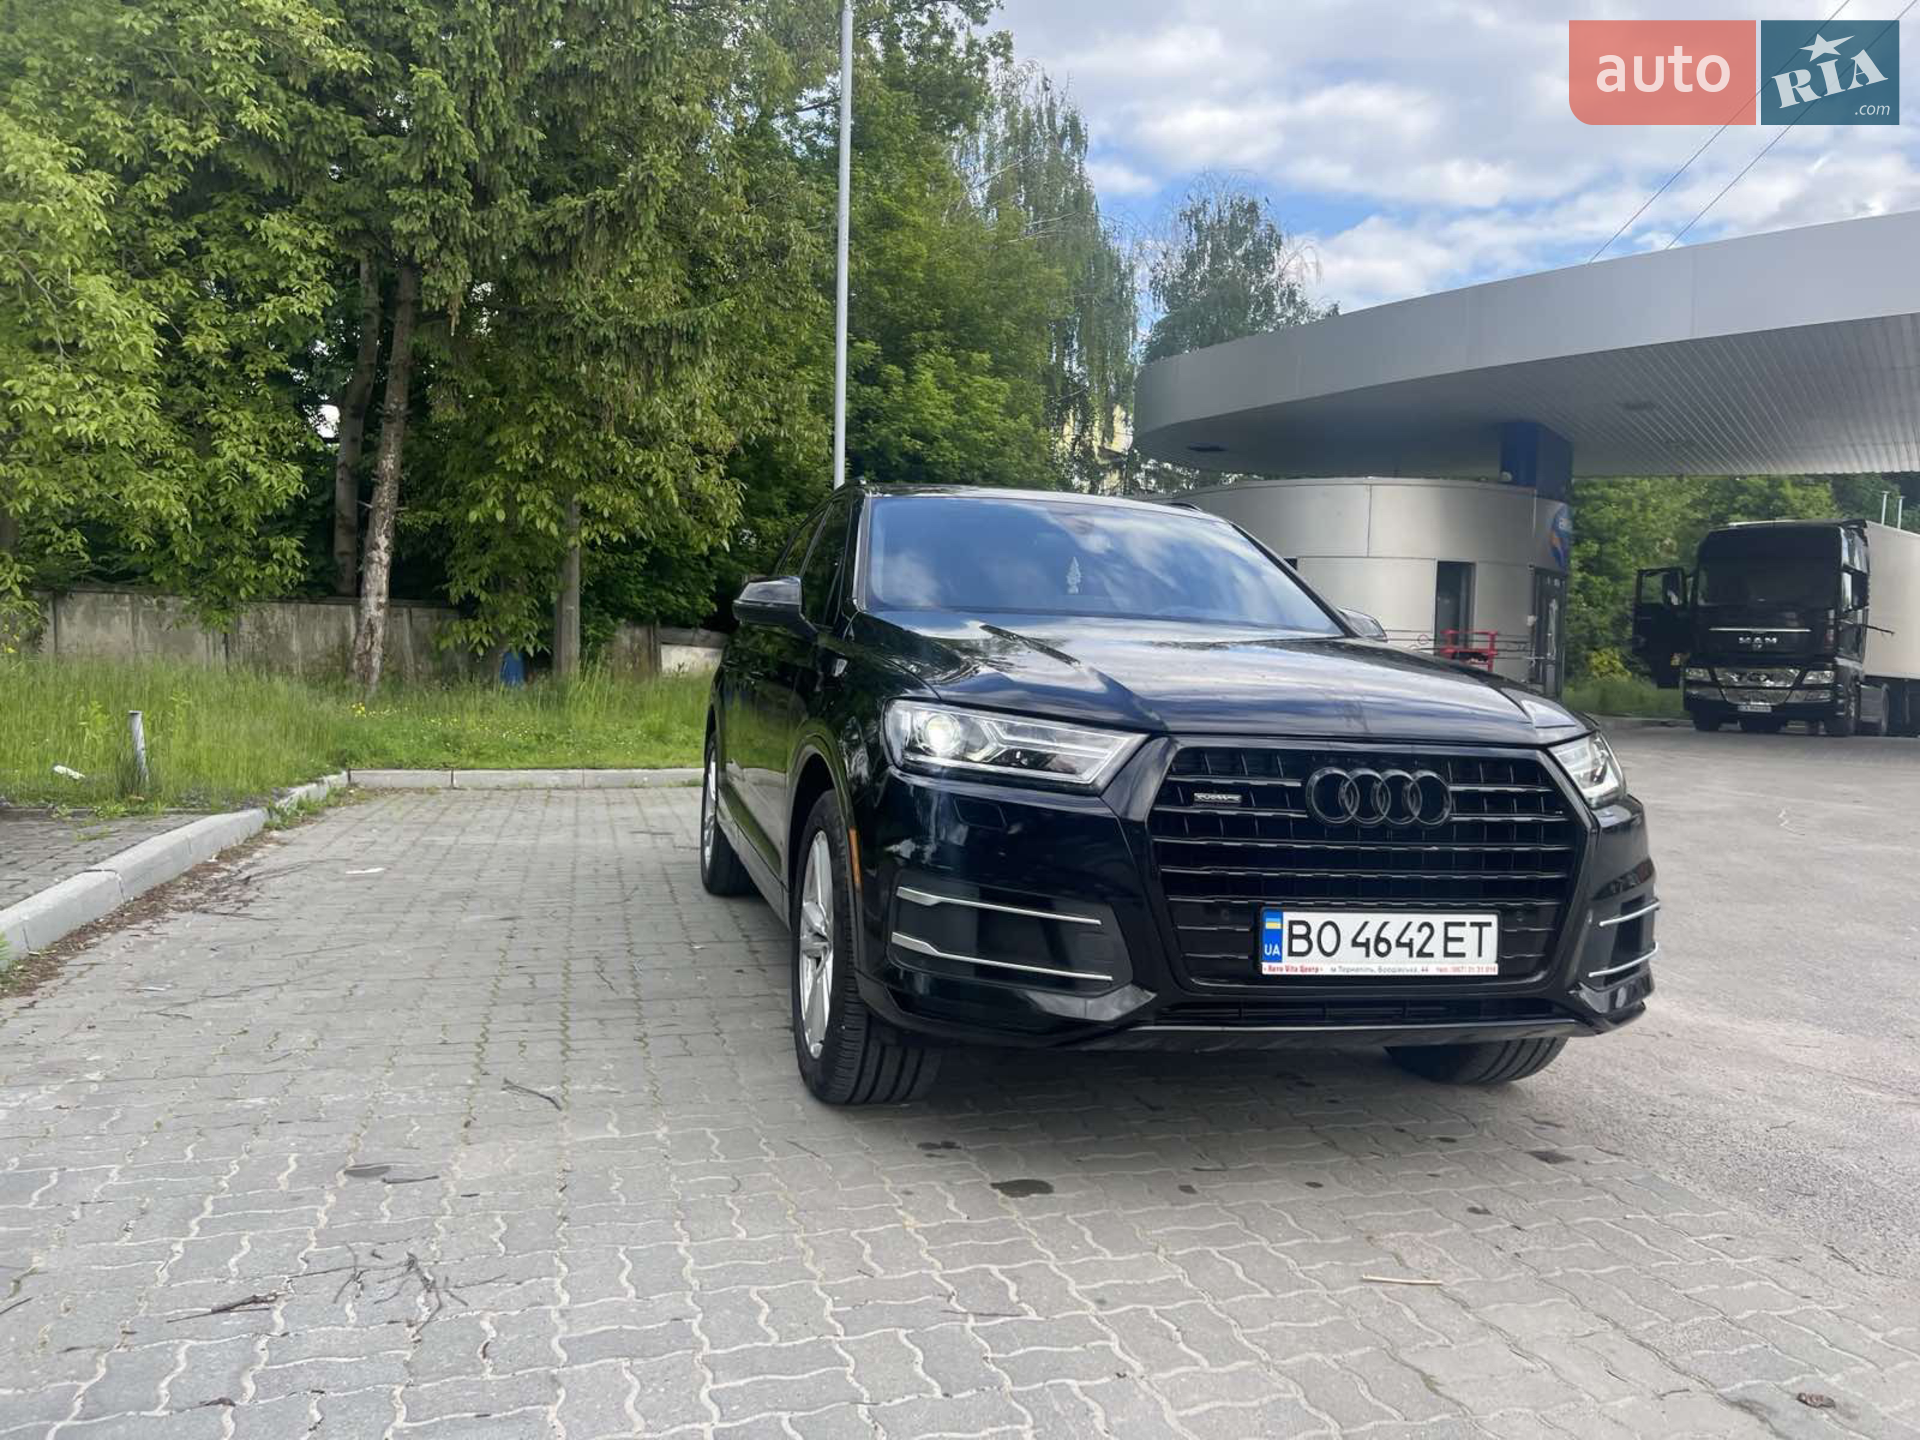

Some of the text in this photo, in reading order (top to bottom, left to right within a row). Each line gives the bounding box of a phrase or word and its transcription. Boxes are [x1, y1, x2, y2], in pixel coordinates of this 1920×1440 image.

[1264, 945, 1281, 957] UA
[1287, 920, 1493, 958] BO 4642 ET
